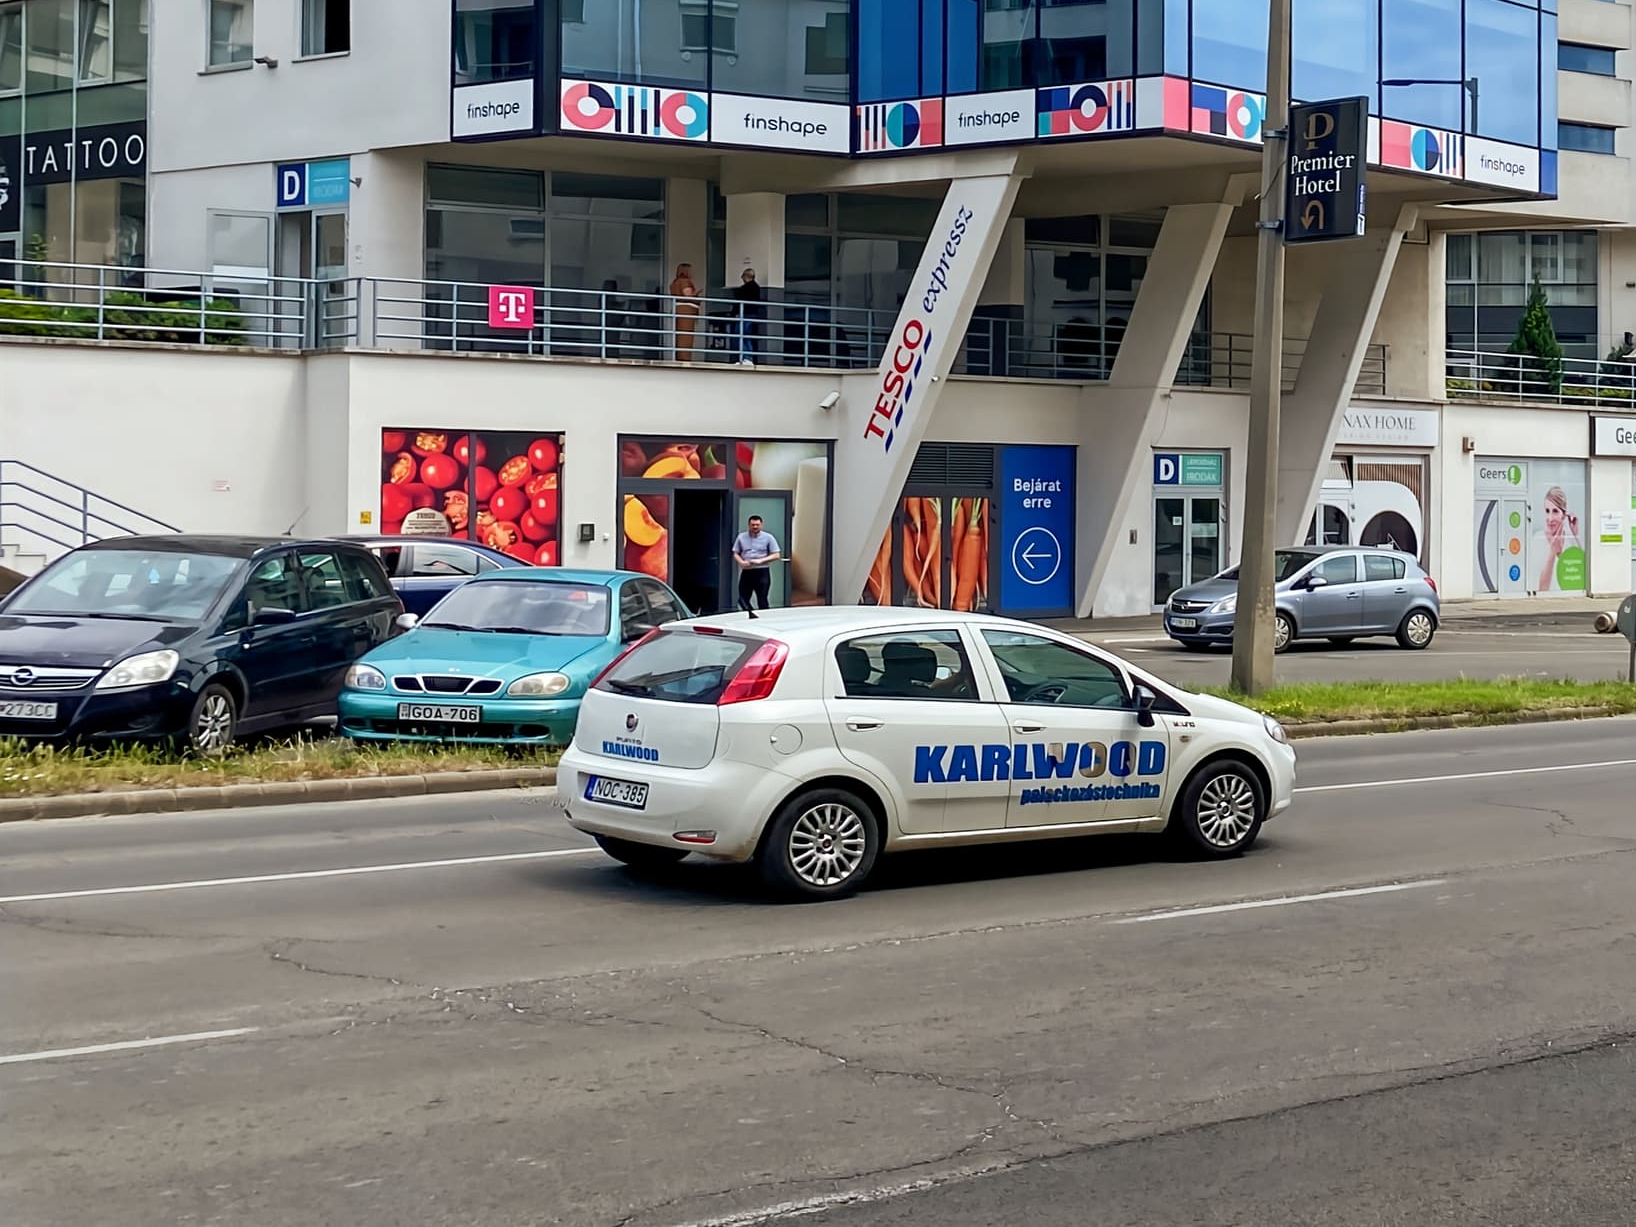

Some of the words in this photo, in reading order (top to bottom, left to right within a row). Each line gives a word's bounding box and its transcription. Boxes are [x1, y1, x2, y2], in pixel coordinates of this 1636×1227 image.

[467, 100, 520, 120] finshape
[958, 110, 1020, 128] finshape
[744, 113, 827, 137] finshape
[26, 134, 145, 175] TATTOO
[1291, 150, 1355, 174] Premier
[1480, 154, 1525, 177] finshape
[283, 170, 300, 201] D
[1295, 170, 1341, 196] Hotel
[922, 205, 974, 314] expressz
[863, 319, 924, 439] TESCO
[1375, 415, 1416, 430] HOME
[1160, 459, 1175, 481] D
[1479, 467, 1507, 480] Geers
[1013, 477, 1062, 495] Bejárat
[1023, 497, 1052, 509] erre
[412, 706, 478, 721] GOA-706
[602, 740, 659, 761] KARLWOOD
[914, 741, 1166, 783] KARLWOOD
[595, 780, 645, 804] NOC-385
